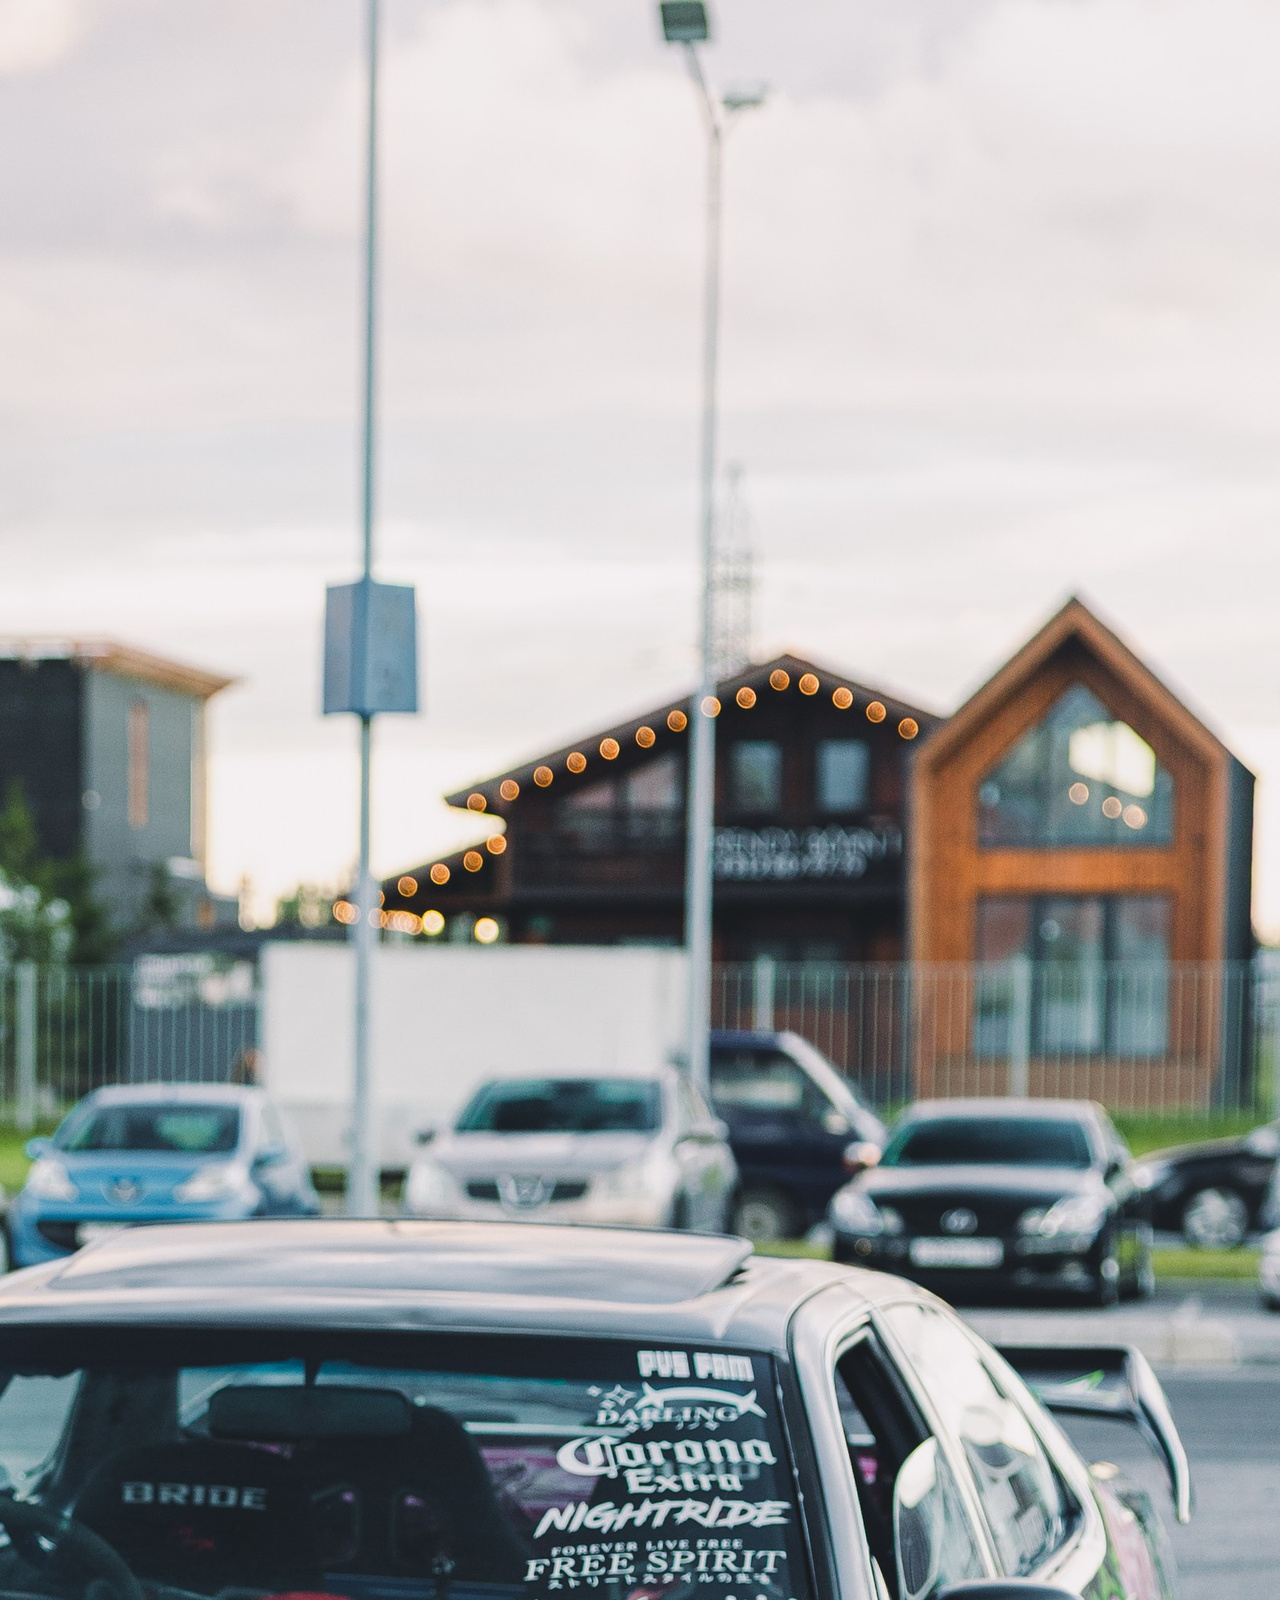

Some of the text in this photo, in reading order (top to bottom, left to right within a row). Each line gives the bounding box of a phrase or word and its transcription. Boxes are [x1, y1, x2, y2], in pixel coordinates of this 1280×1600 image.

[693, 1351, 755, 1383] FAM
[596, 1406, 740, 1426] DARLING
[556, 1434, 778, 1479] Corona
[122, 1480, 269, 1512] BRIDE
[623, 1467, 744, 1495] Extra
[533, 1496, 793, 1540] NIGHTRIDE
[551, 1538, 744, 1558] FOREVER LIVE FREE
[523, 1549, 788, 1583] FREE SPIRIT
